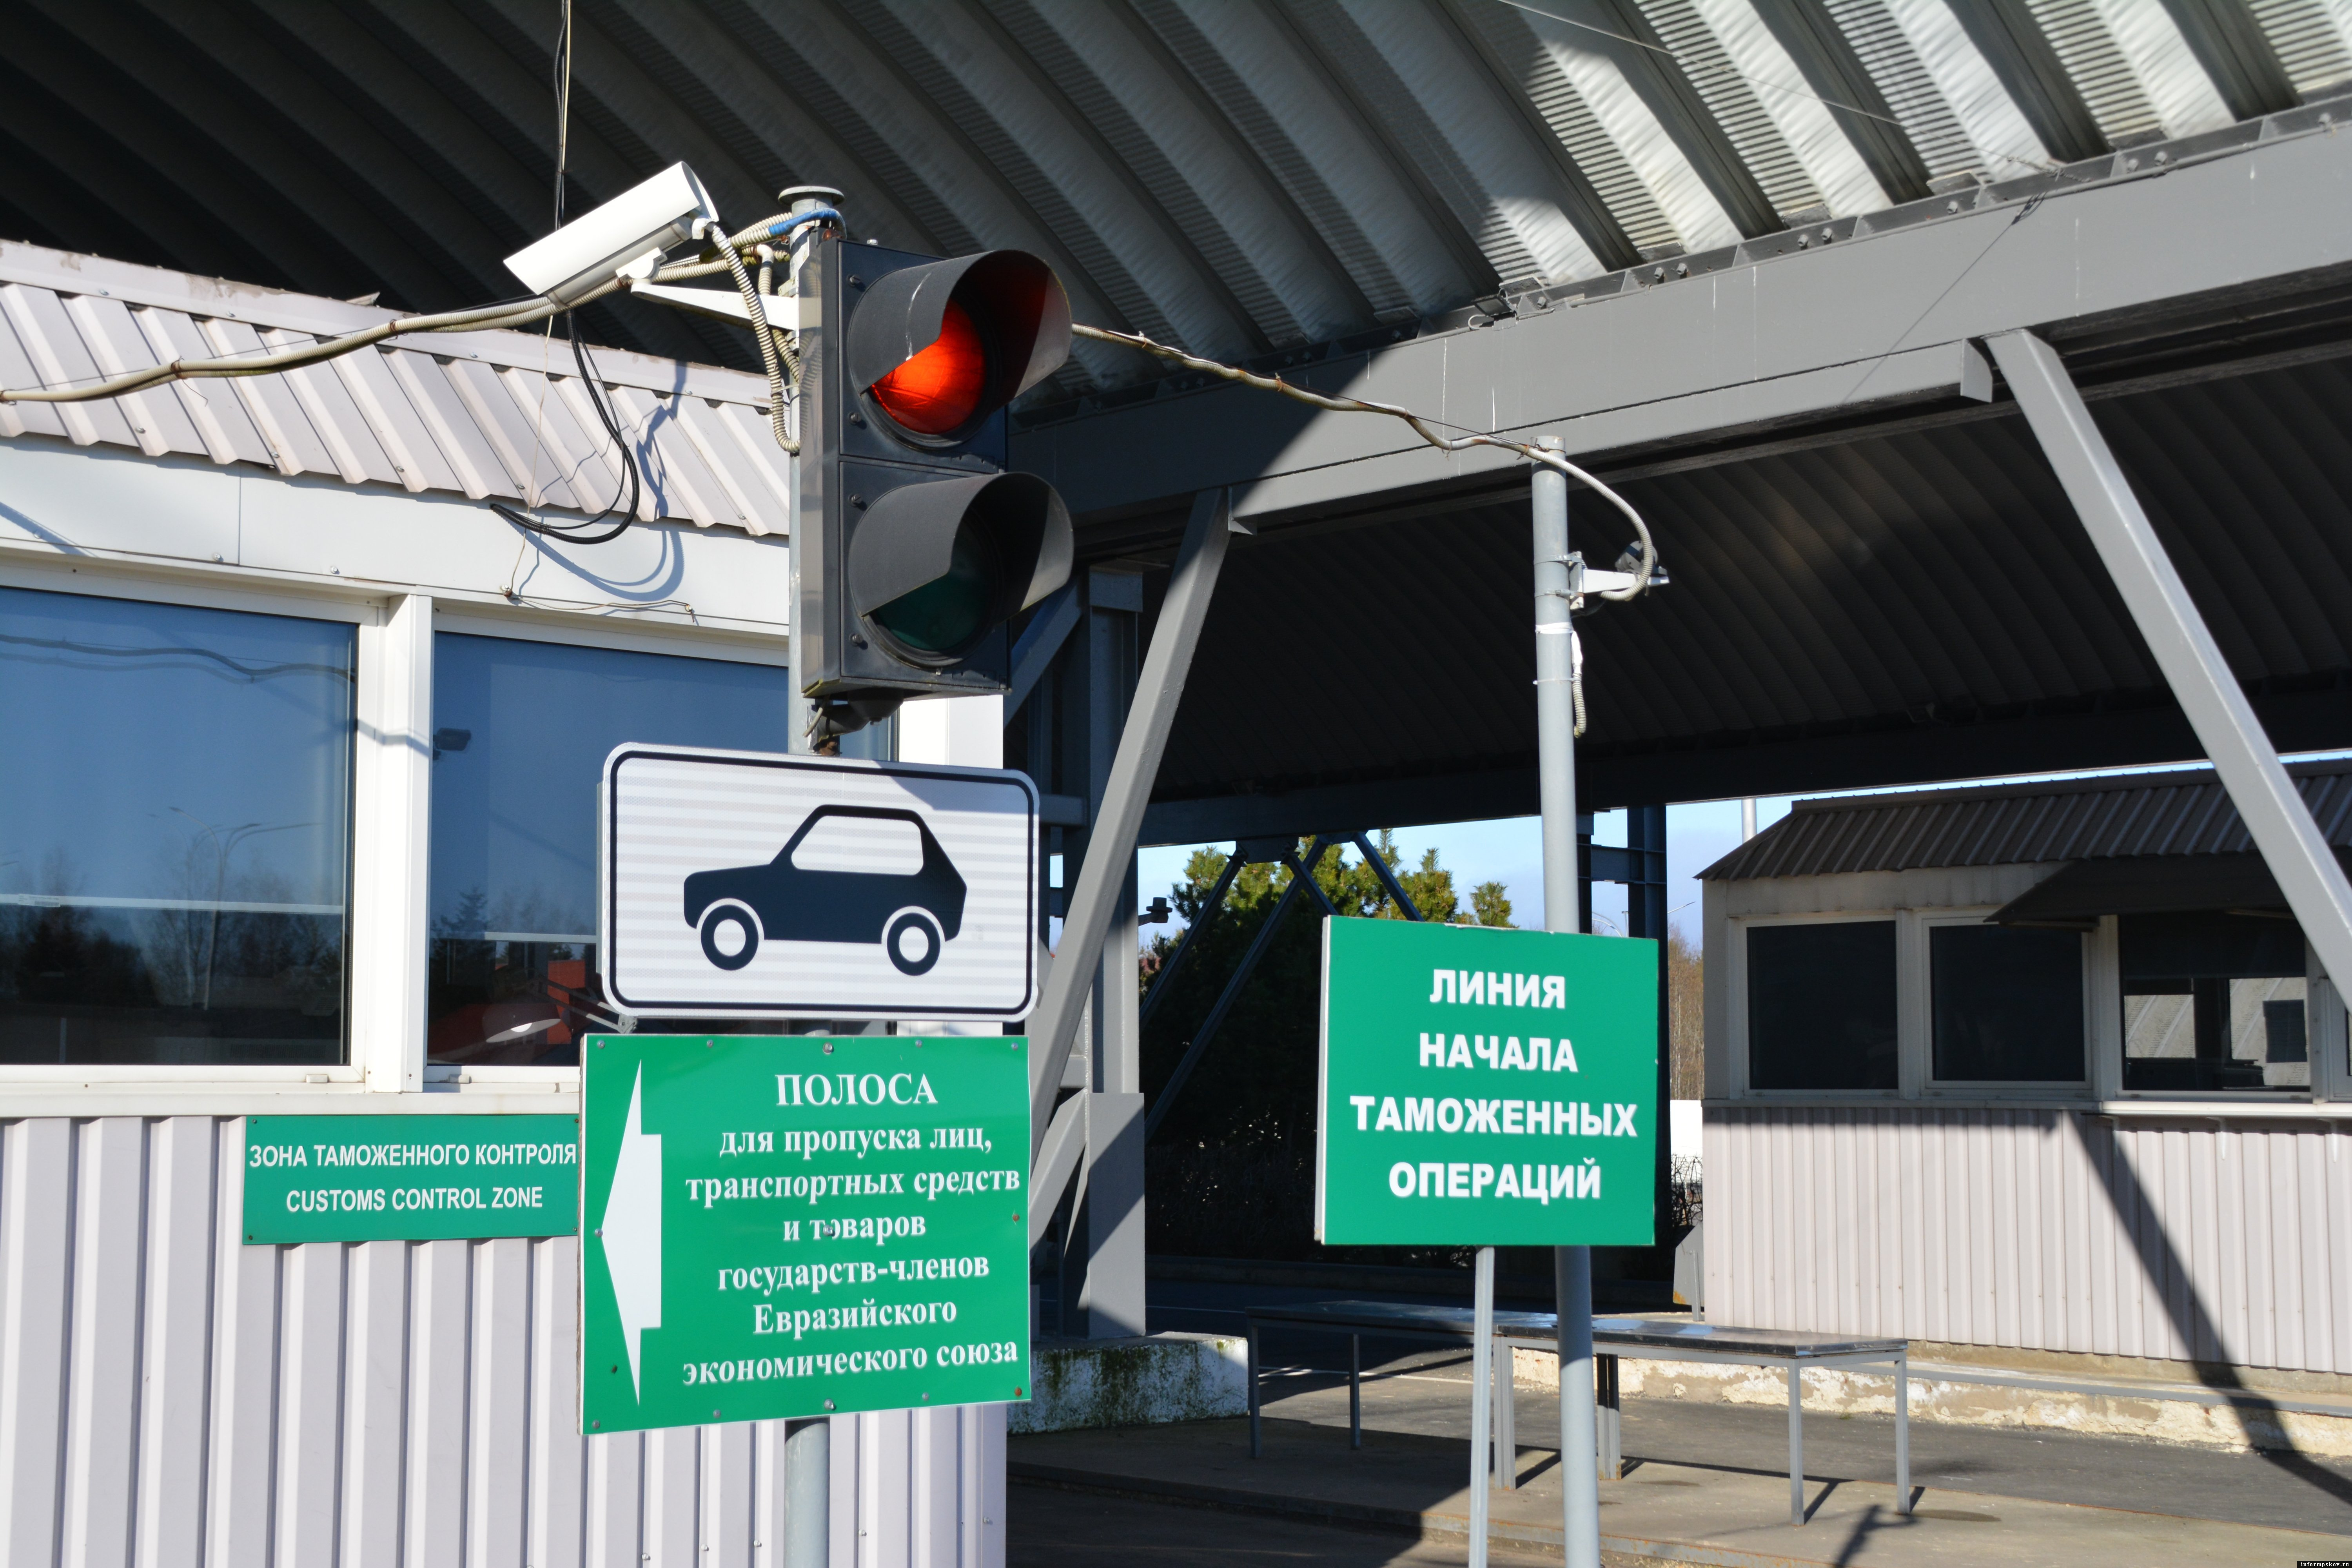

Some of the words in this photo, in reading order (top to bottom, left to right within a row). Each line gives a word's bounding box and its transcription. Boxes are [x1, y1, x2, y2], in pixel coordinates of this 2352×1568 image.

[1430, 969, 1565, 1009] ЛИНИЯ
[1420, 1033, 1578, 1072] НАЧАЛА
[775, 1073, 938, 1105] ПОЛОСА
[1350, 1096, 1637, 1136] ТАМОЖЕННЫХ
[250, 1145, 307, 1167] ЗОНА
[314, 1144, 469, 1166] ТАМОЖЕННОГО
[476, 1144, 576, 1164] КОНТРОЛЯ
[720, 1132, 773, 1157] для
[785, 1129, 921, 1160] пропуска
[930, 1129, 991, 1152] лиц,
[287, 1189, 385, 1212] CUSTOMS
[392, 1188, 486, 1210] CONTROL
[492, 1187, 542, 1208] ZONE
[686, 1174, 904, 1208] транспортных
[914, 1171, 1019, 1200] средств
[1389, 1158, 1601, 1205] ОПЕРАЦИЙ
[784, 1221, 799, 1241] и
[810, 1216, 926, 1245] товаров
[719, 1257, 989, 1296] государств-членов
[754, 1298, 956, 1339] Евразийского
[684, 1348, 927, 1384] экономического
[937, 1342, 1018, 1367] союза
